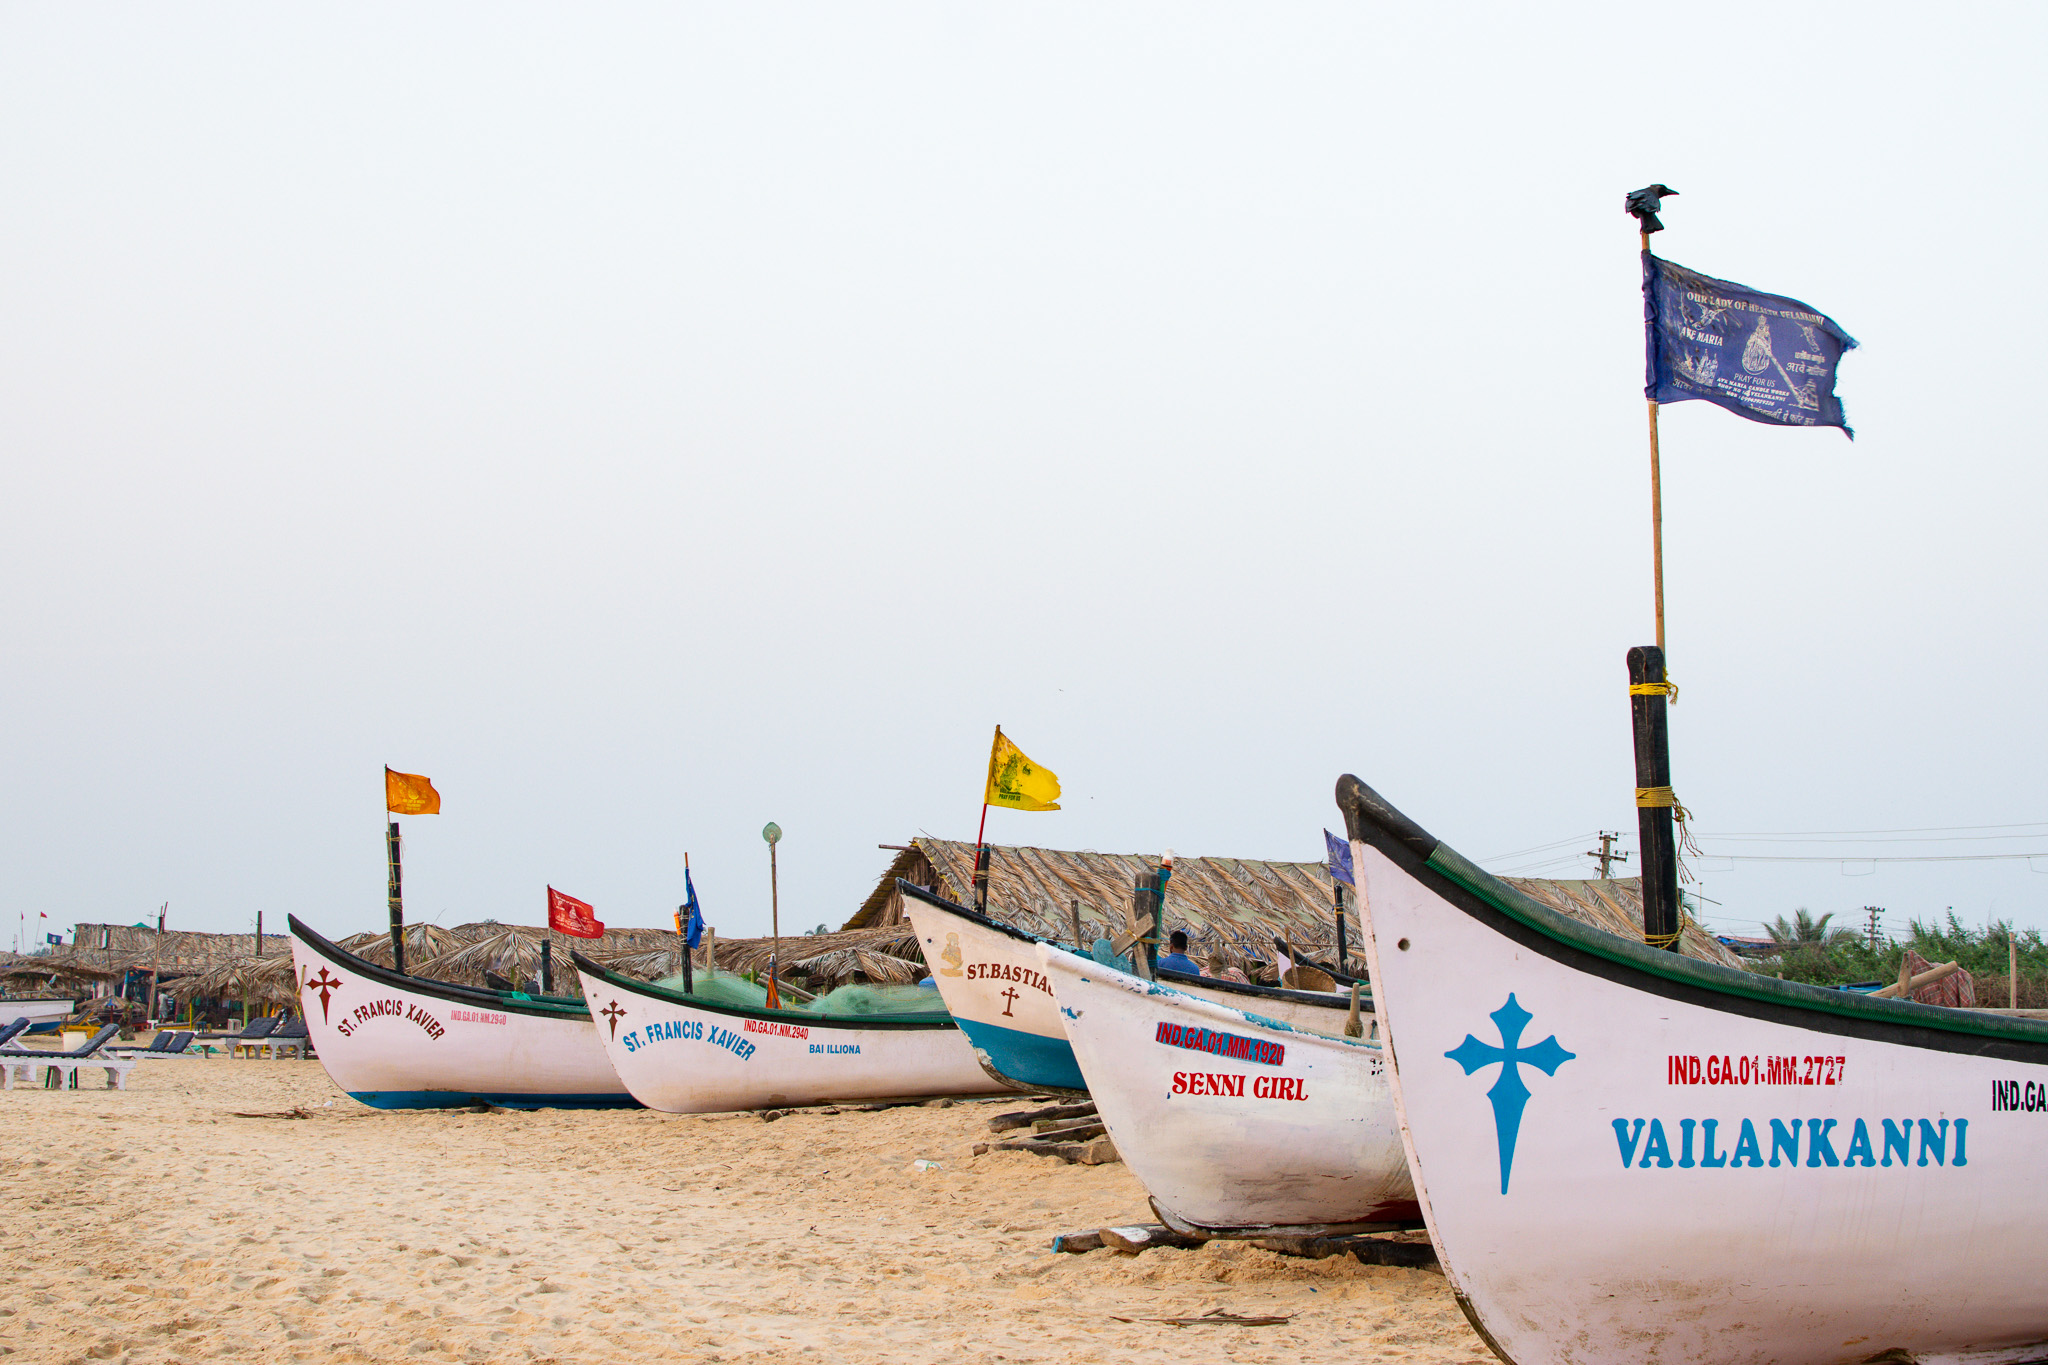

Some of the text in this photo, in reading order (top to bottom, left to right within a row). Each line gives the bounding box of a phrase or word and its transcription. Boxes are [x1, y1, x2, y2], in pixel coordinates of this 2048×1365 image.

[1686, 291, 1709, 304] OUR
[1709, 296, 1733, 309] LADY
[1734, 300, 1747, 311] OF
[1696, 332, 1723, 346] MARIA
[1733, 372, 1776, 388] PRAY FOR US
[353, 999, 403, 1024] FRANCIS
[405, 1003, 446, 1041] XAVIER
[645, 1020, 703, 1044] FRANCIS
[707, 1025, 757, 1061] XAVIER
[809, 1043, 861, 1055] BAI ILLIONA
[1155, 1021, 1285, 1066] IND.GA.01.MM.1920
[1171, 1071, 1309, 1101] SENNI GIRL
[1611, 1117, 1969, 1169] VAILANKANNI
